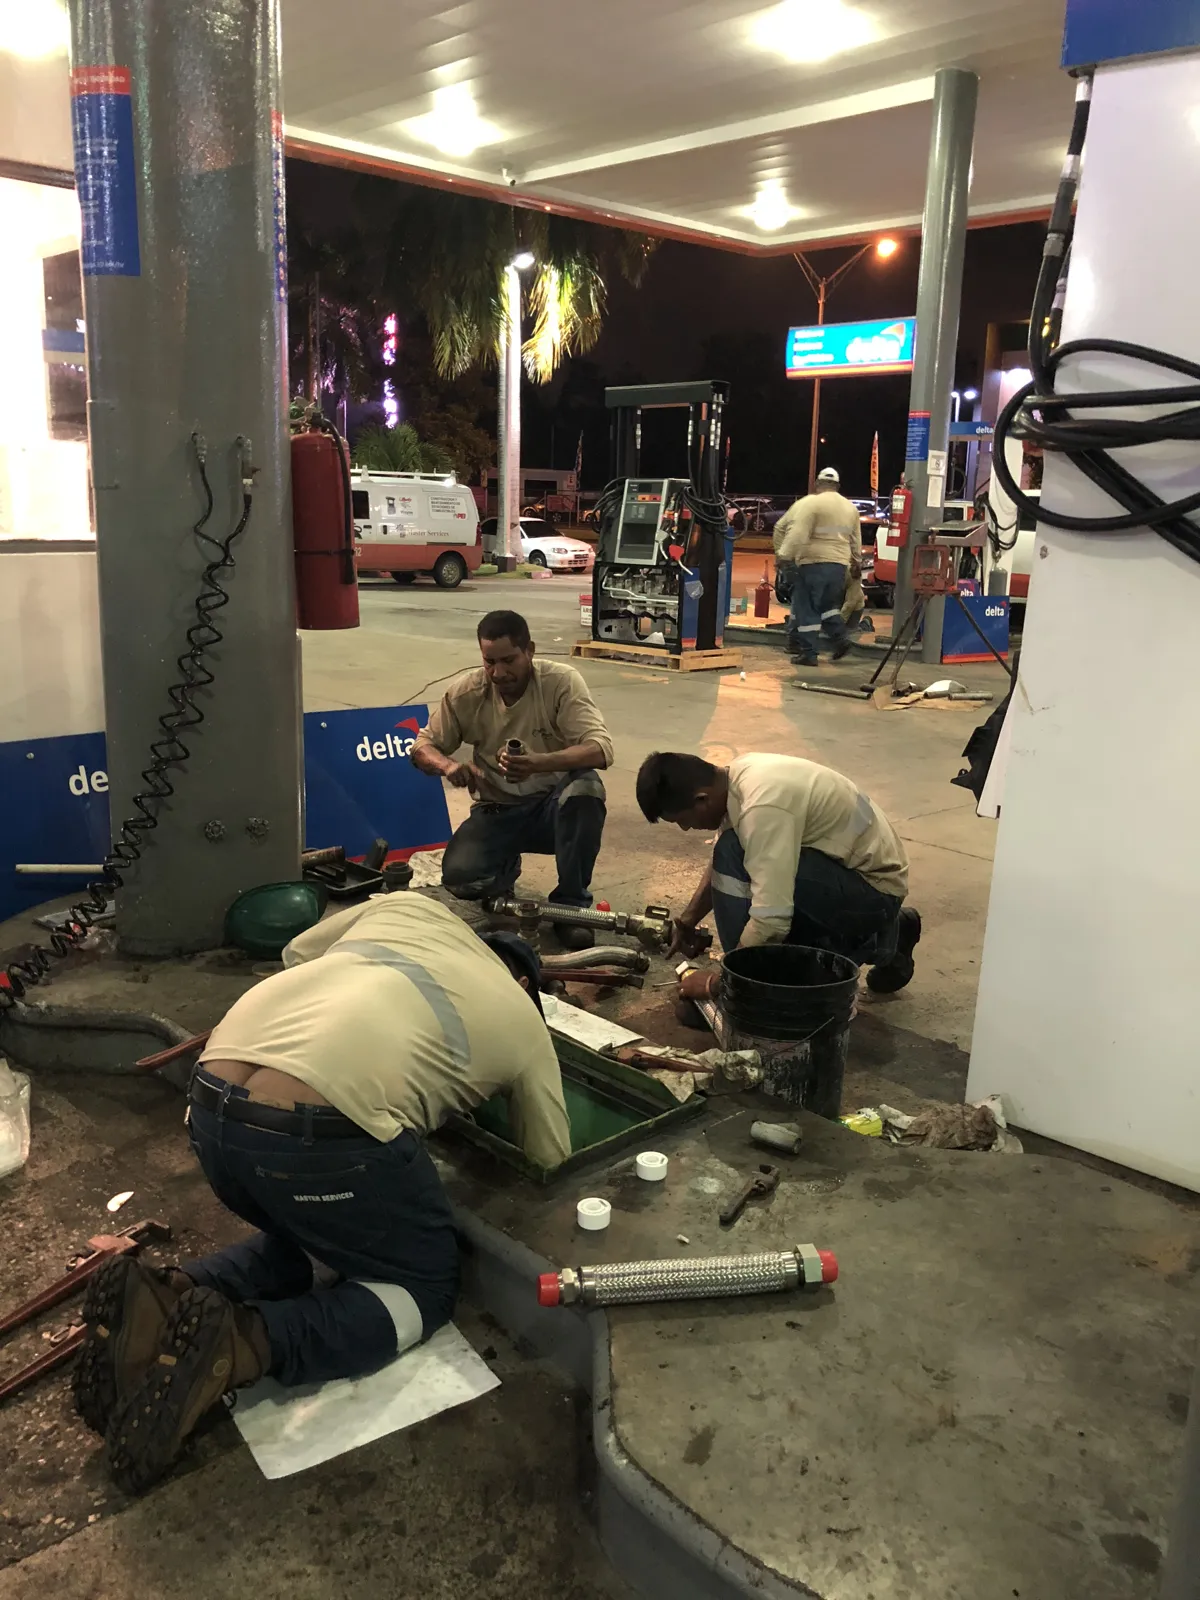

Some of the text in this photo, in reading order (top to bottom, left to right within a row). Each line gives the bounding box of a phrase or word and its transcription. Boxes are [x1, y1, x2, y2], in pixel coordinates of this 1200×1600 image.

[975, 425, 994, 434] delta
[960, 588, 974, 596] elta
[985, 606, 1004, 616] delta
[356, 733, 417, 762] delta
[321, 1191, 354, 1201] SERVICES
